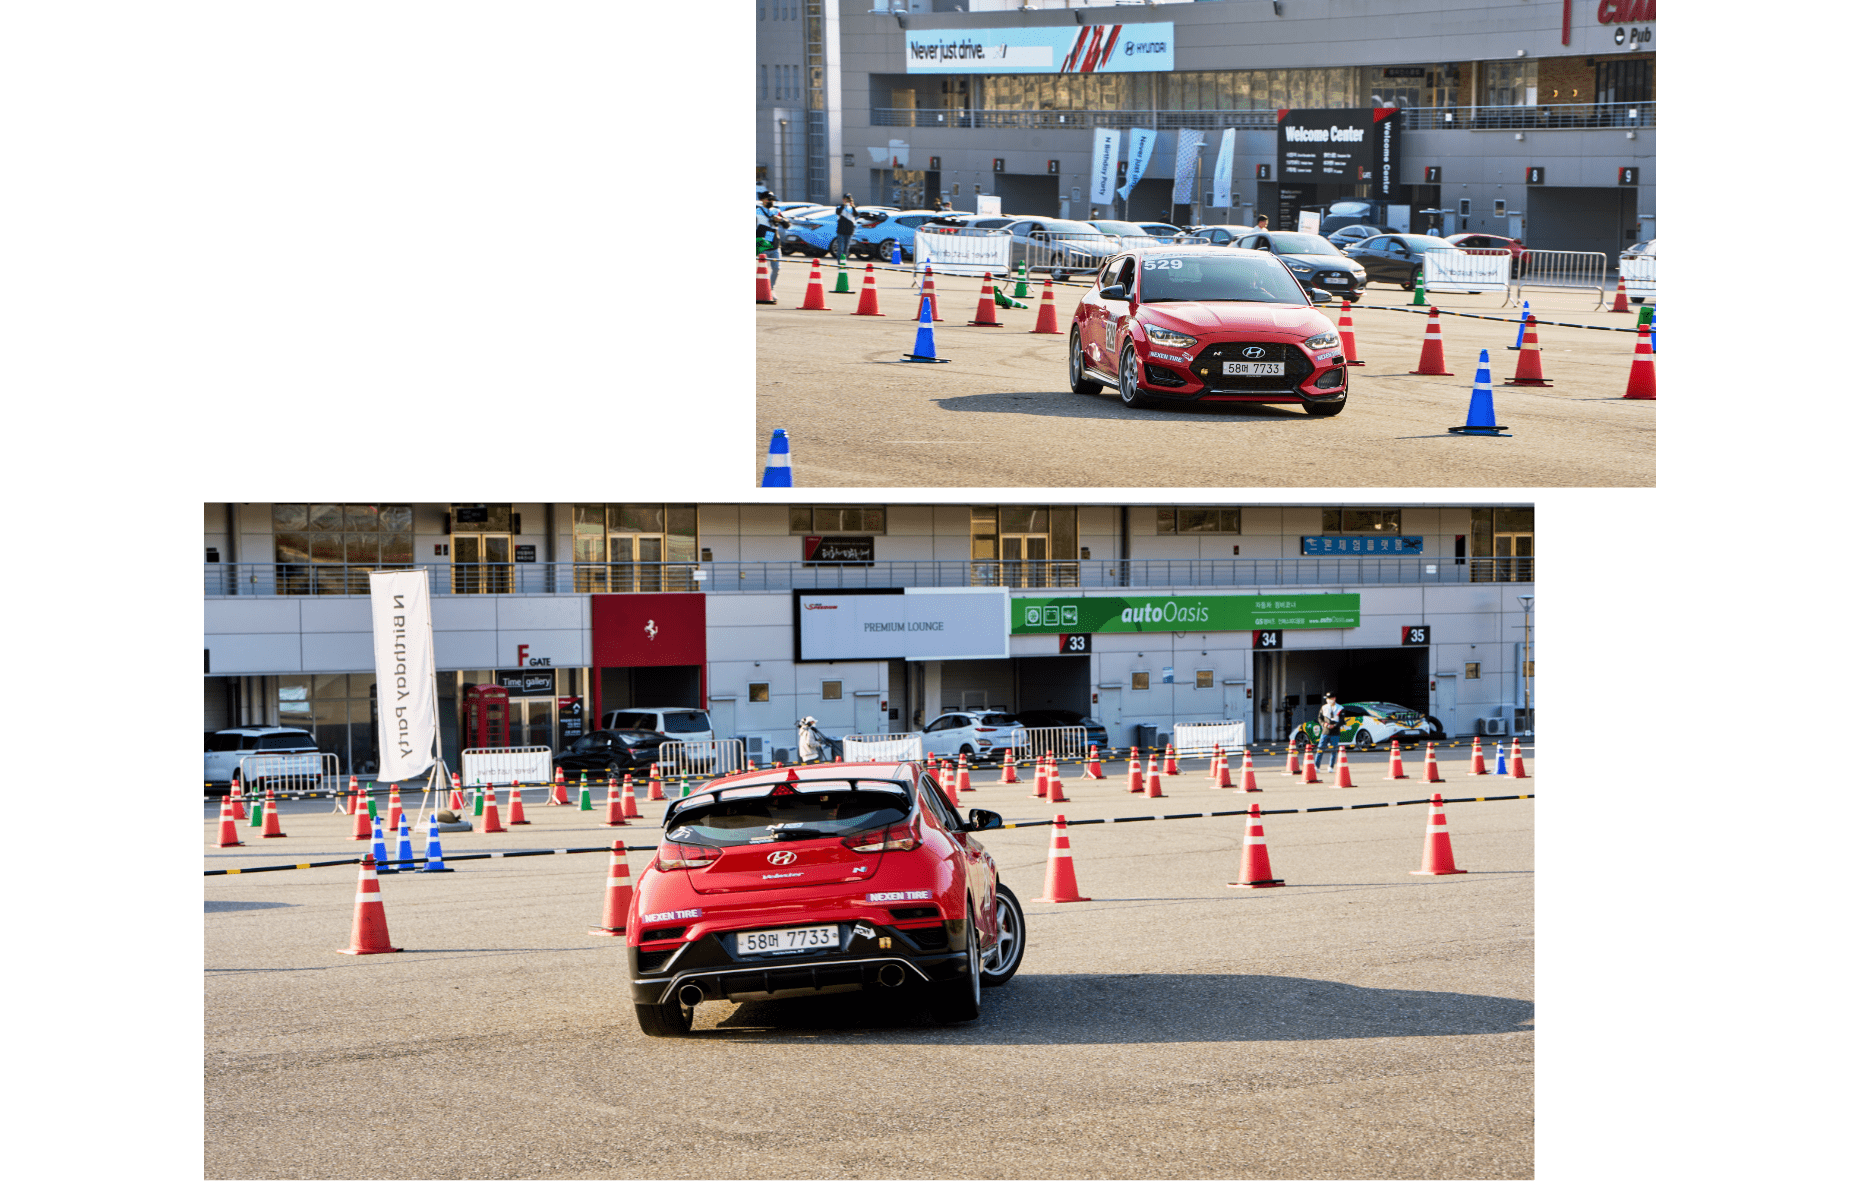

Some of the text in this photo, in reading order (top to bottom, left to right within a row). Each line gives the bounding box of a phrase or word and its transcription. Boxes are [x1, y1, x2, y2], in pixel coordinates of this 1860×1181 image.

[1630, 27, 1651, 43] Pub
[911, 41, 939, 59] Never
[939, 39, 958, 62] just
[958, 38, 985, 59] drive.
[1136, 41, 1167, 54] HYUNDAI
[1285, 125, 1364, 142] Welcome Center
[1100, 144, 1111, 175] Birthday
[1383, 121, 1391, 194] Welcome Center
[1260, 166, 1266, 178] 6
[1430, 169, 1436, 180] 7
[1532, 169, 1538, 182] 8
[1625, 170, 1632, 182] 9
[1098, 176, 1108, 196] Party
[1144, 259, 1183, 270] 529
[1150, 351, 1169, 359] NEXEN
[1169, 355, 1183, 363] TIRE
[1228, 363, 1279, 373] 58머 7733
[1122, 601, 1209, 623] autoOasis
[864, 622, 944, 632] PREMIUM LOUNGE
[1262, 632, 1276, 646] 34
[1411, 629, 1425, 643] 35
[1069, 636, 1085, 651] 33
[518, 644, 551, 667] F GATE
[502, 676, 551, 688] Time gallery
[870, 890, 928, 902] NEXEN TIRE
[644, 909, 698, 923] NEXEN TIRE
[747, 929, 829, 950] 58머 7733
